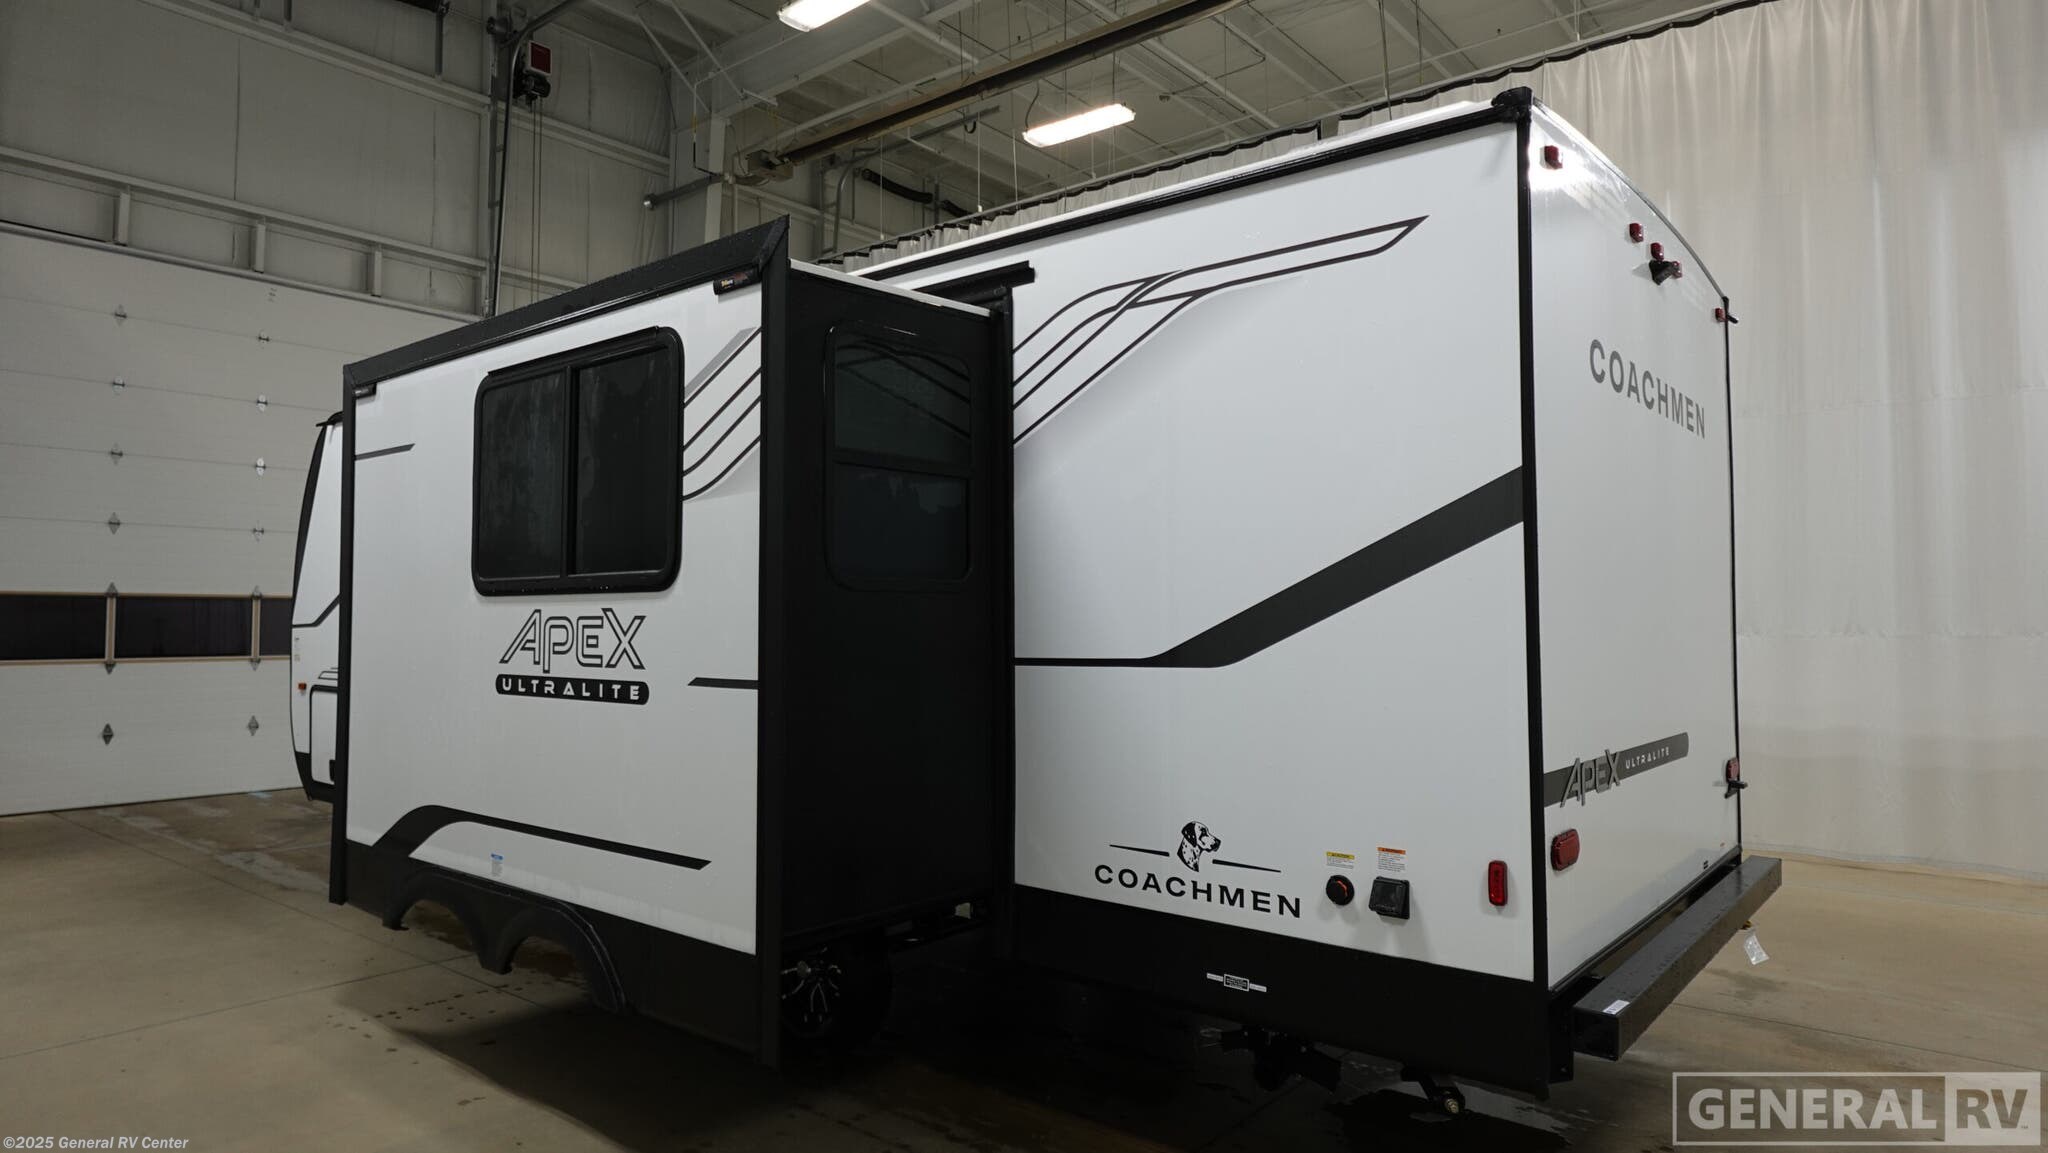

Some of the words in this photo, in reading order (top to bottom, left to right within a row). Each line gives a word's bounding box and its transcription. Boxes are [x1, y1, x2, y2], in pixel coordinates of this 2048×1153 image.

[1590, 339, 1705, 439] COACHMEN
[499, 608, 647, 674] APEX
[502, 678, 640, 700] ULTRALITE
[1560, 749, 1621, 808] APEX
[1625, 746, 1670, 769] ULTRALITE
[1095, 864, 1301, 918] COACHMEN
